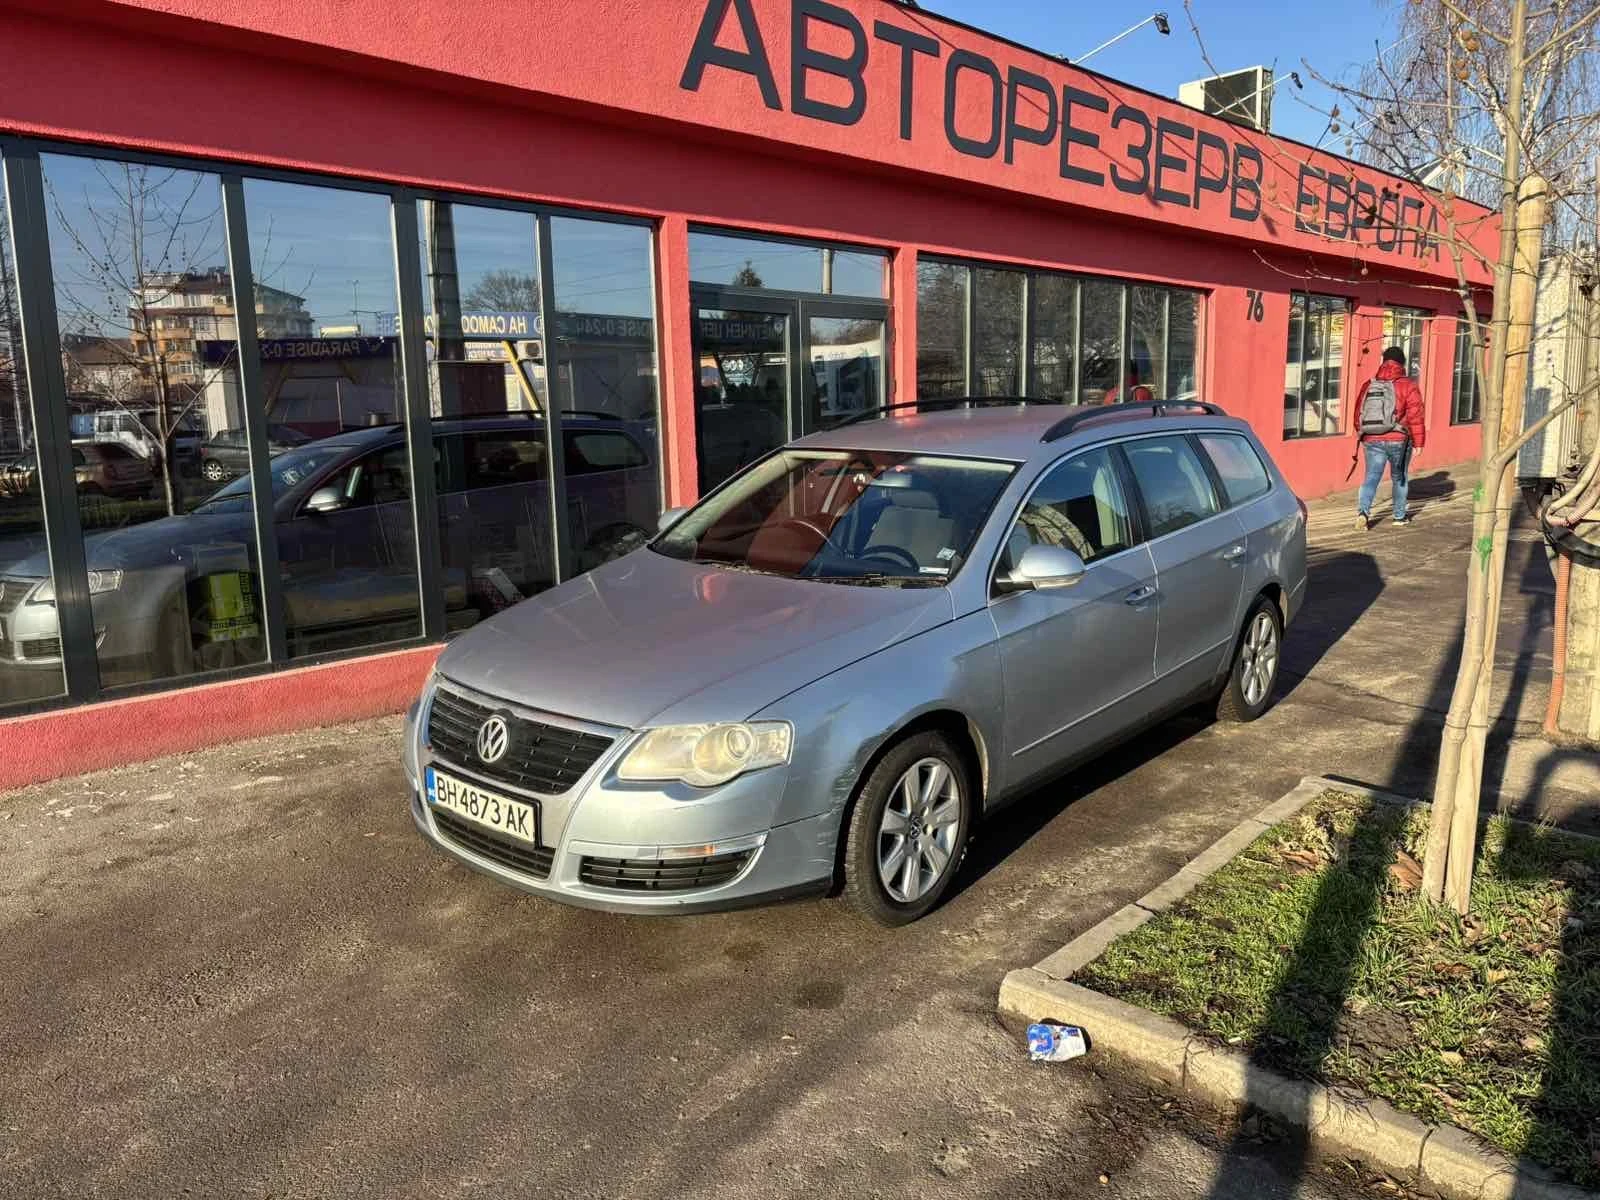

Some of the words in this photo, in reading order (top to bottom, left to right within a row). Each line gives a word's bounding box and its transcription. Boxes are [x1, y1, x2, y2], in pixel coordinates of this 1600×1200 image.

[679, 0, 1263, 222] АВТОРЕЗЕРВ
[1296, 165, 1440, 262] ЕВРОПА
[1247, 290, 1264, 322] 76
[460, 787, 501, 825] 4873
